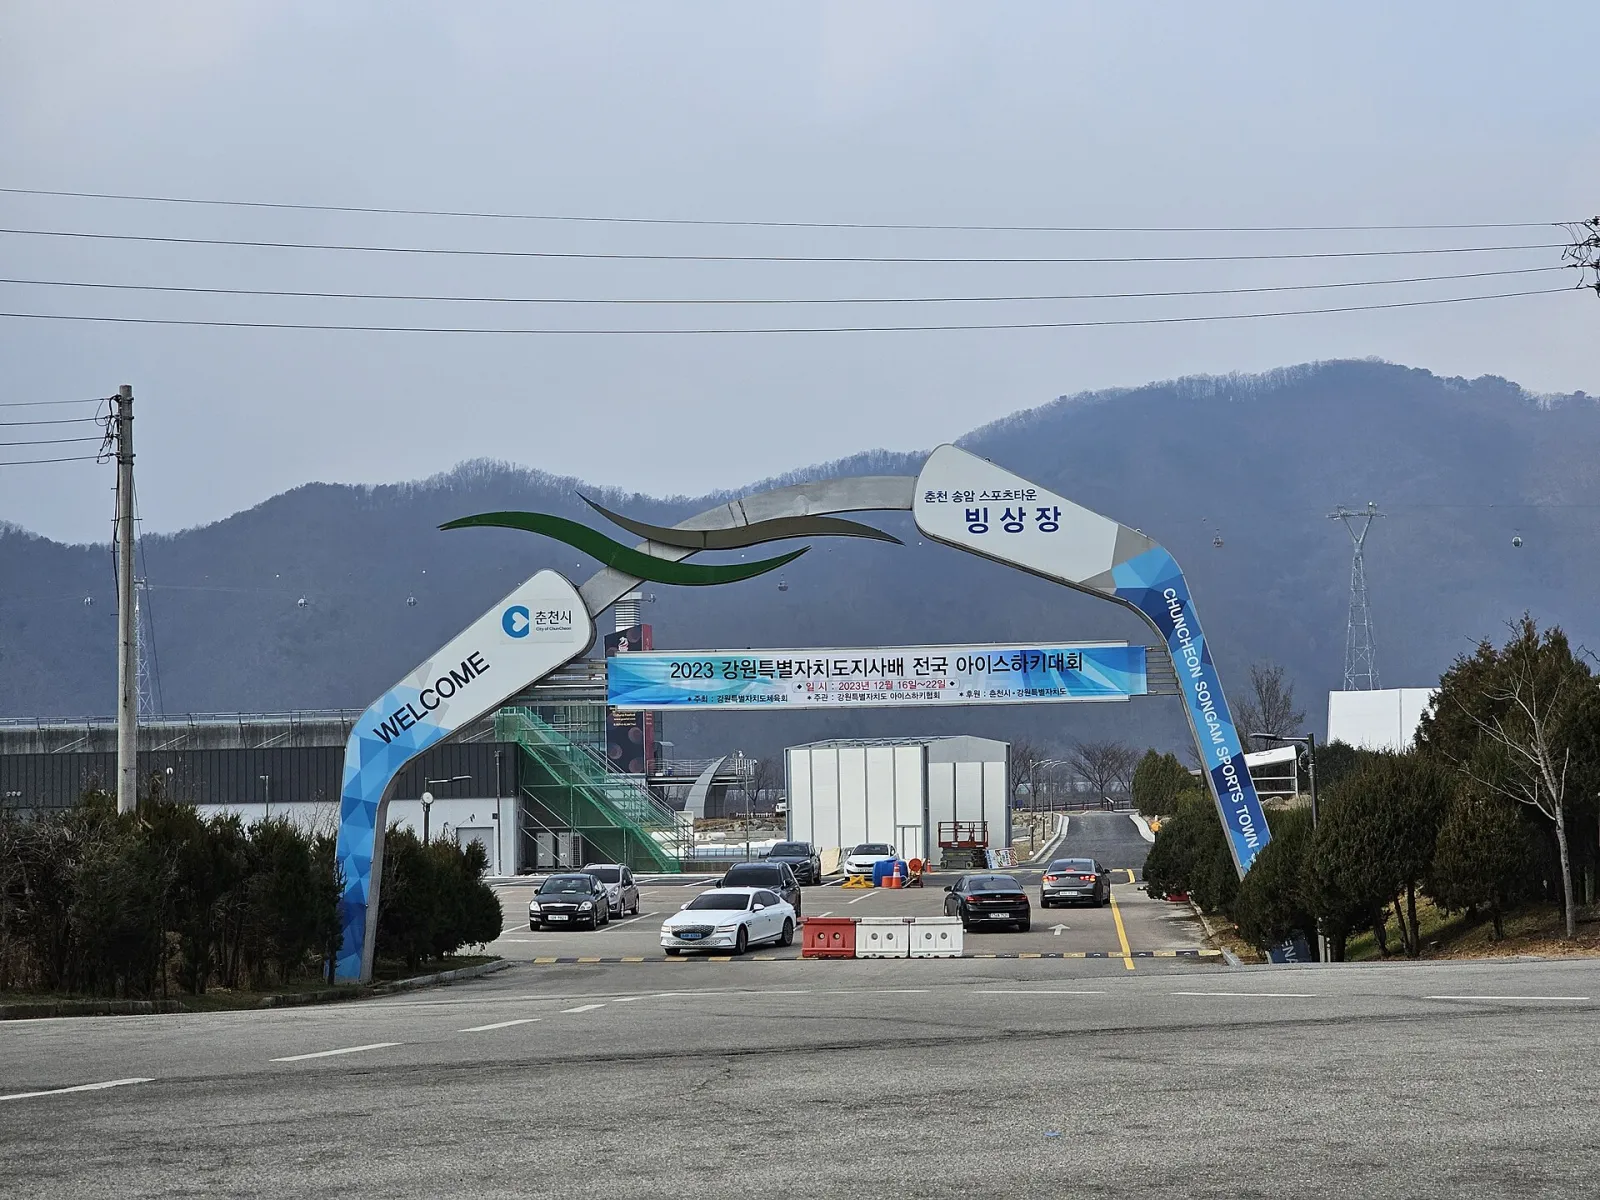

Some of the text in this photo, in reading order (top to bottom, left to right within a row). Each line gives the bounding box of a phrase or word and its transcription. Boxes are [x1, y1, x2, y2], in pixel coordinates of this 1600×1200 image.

[924, 488, 1037, 503] 춘천 송암 스포츠타운
[535, 610, 572, 625] 춘천시
[670, 651, 1083, 680] 2023 강원특별자치도지사배 전국 아이스하키대회
[838, 681, 870, 691] 2023년
[873, 680, 894, 690] 12월
[372, 650, 491, 745] WELCOME
[693, 694, 708, 703] 주최
[717, 694, 788, 703] 강원특별자치도체육회
[813, 693, 828, 702] 주관
[837, 692, 888, 701] 강원특별자치도
[889, 691, 941, 700] 아이스하키협회
[965, 690, 981, 698] 후원
[1163, 587, 1203, 678] CHUNCHEON
[1194, 681, 1225, 745] SONGAM
[1216, 746, 1244, 803] SPORTS
[1236, 804, 1260, 848] TOWN
